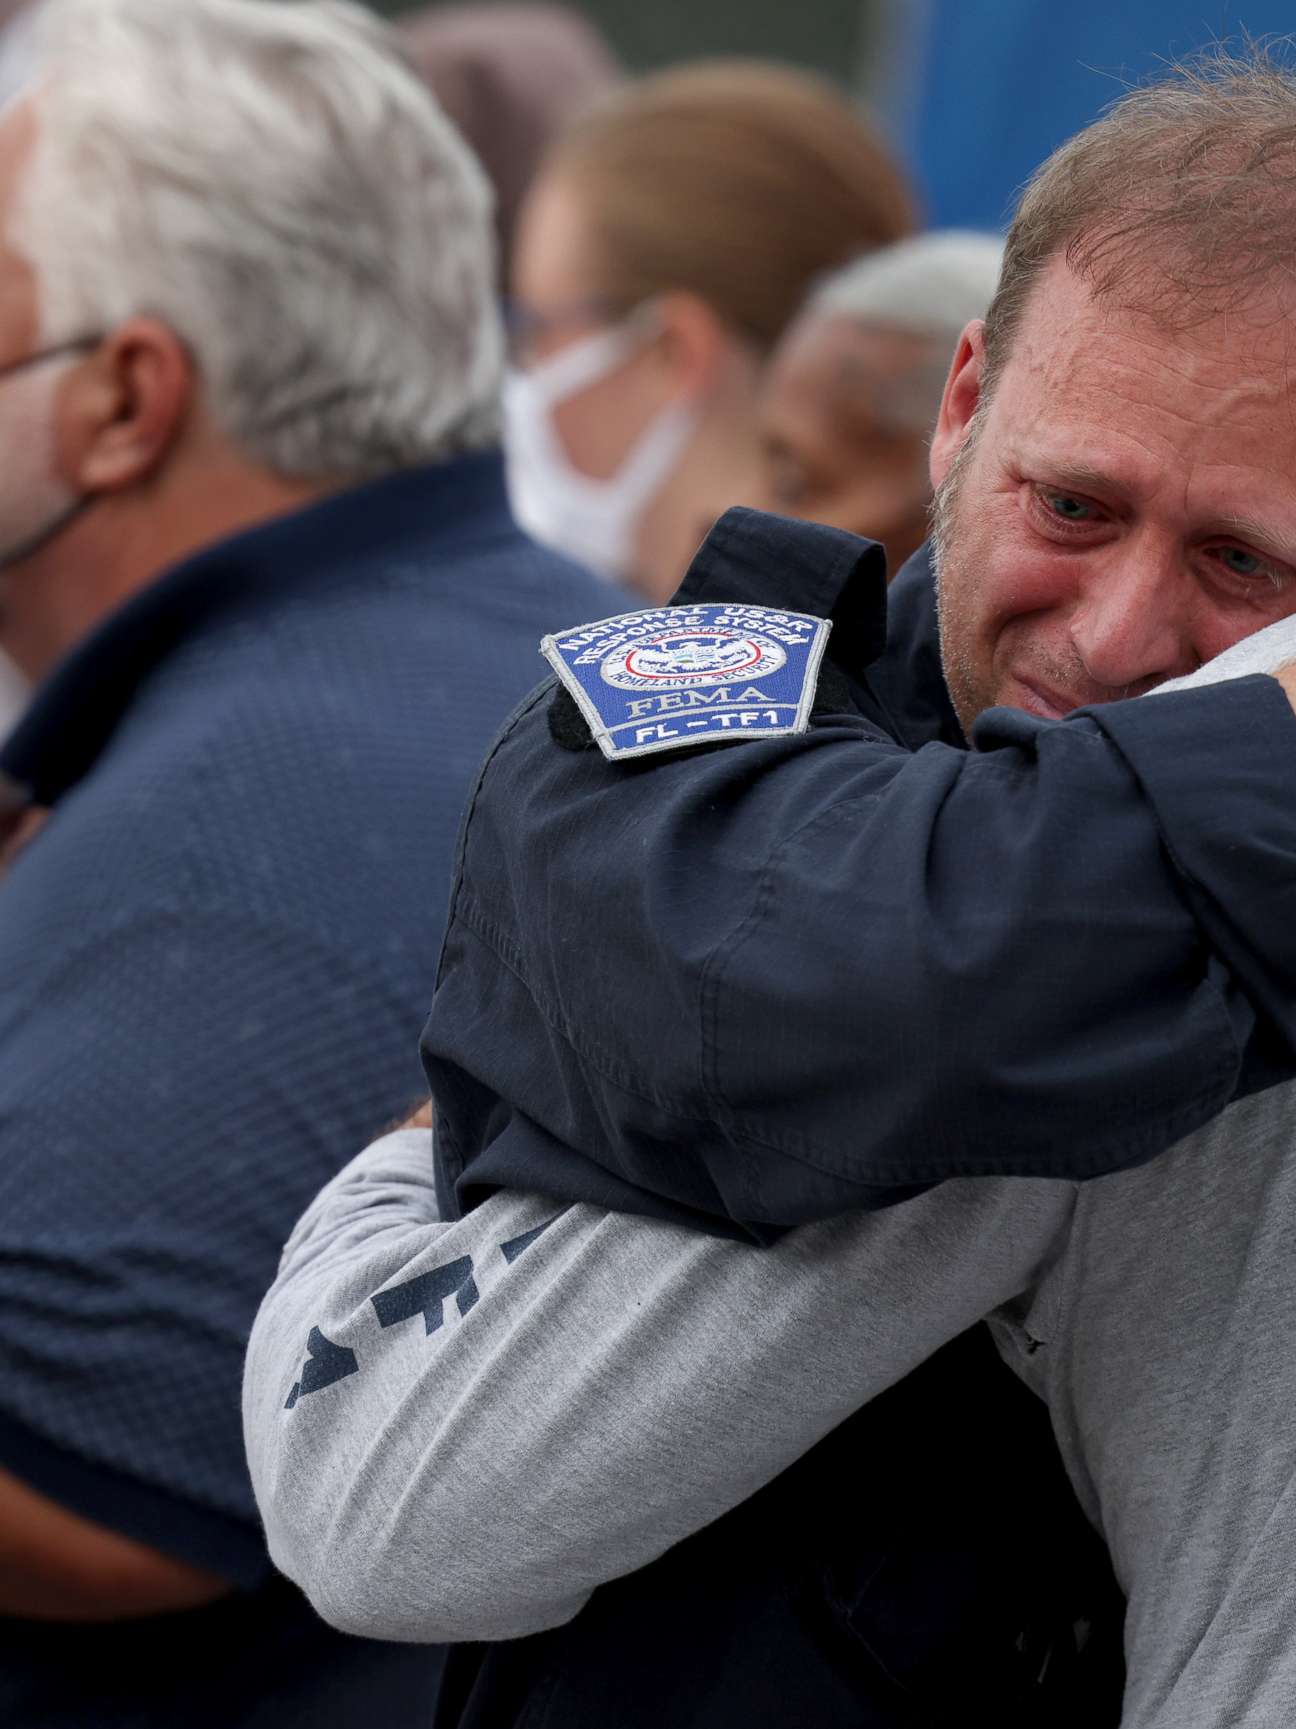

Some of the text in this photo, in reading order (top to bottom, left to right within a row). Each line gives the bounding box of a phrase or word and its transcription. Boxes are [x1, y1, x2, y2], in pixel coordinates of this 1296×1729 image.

[558, 607, 813, 651] NATIONAL US&R
[573, 615, 809, 665] RESPONSE SYSTEM
[610, 654, 779, 687] HOMELAND SECURITY
[624, 686, 777, 719] FEMA
